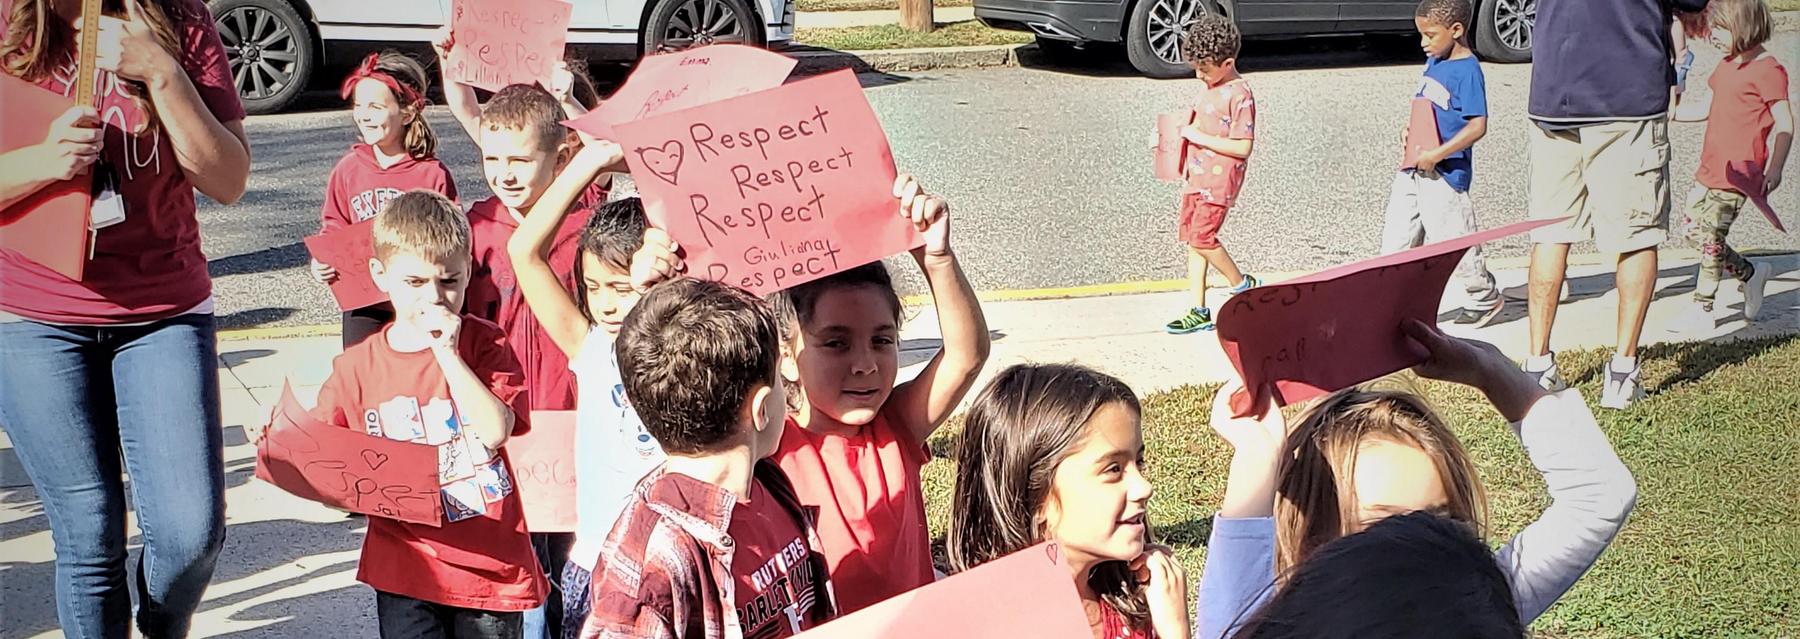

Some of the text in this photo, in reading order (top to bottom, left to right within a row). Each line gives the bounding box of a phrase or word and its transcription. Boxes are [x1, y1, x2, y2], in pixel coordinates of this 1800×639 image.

[689, 105, 829, 162] Respect
[730, 146, 853, 199] Respect
[690, 185, 825, 248] Respect
[743, 239, 825, 265] Giuliana
[751, 536, 807, 593] RUTERS
